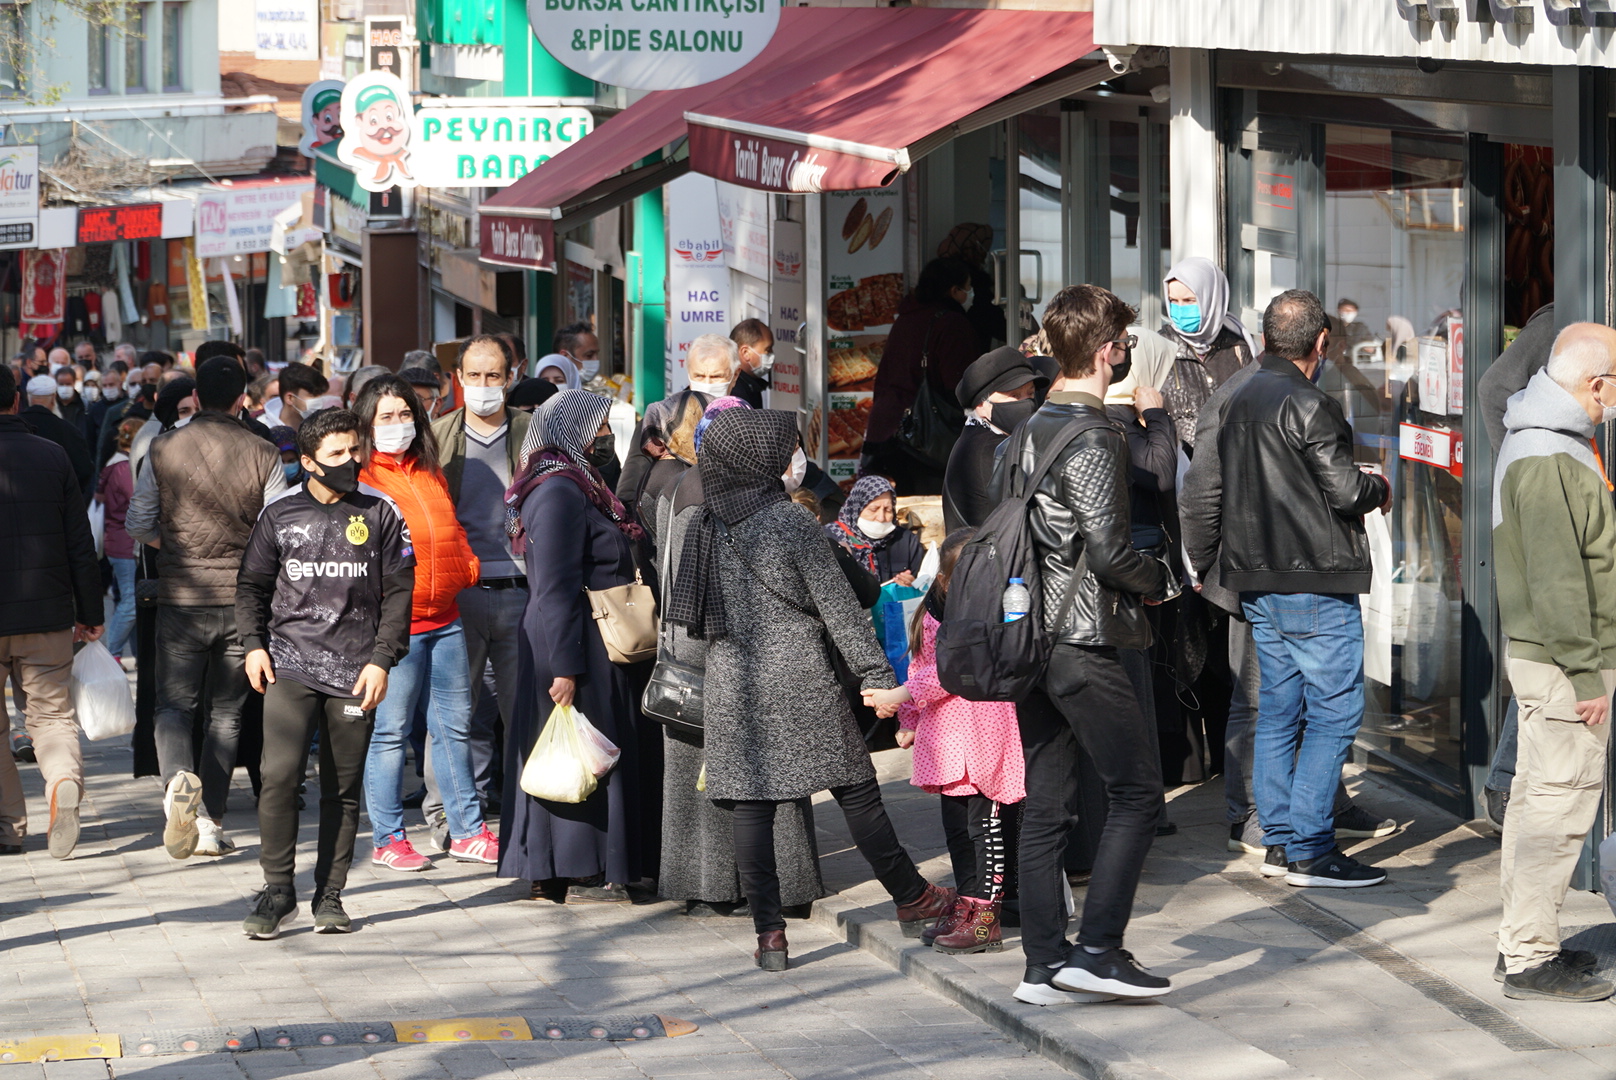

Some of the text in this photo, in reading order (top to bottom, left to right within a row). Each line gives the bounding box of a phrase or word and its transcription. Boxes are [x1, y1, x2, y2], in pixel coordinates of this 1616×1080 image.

[571, 24, 743, 53] &PİDE SALONU
[734, 139, 759, 181] Tarihi
[761, 146, 785, 187] Bursa
[679, 238, 719, 251] ebabil
[688, 290, 719, 302] HAC
[681, 310, 725, 323] UMRE
[780, 306, 799, 321] HAC
[776, 328, 797, 344] UMR
[350, 525, 365, 538] BVB
